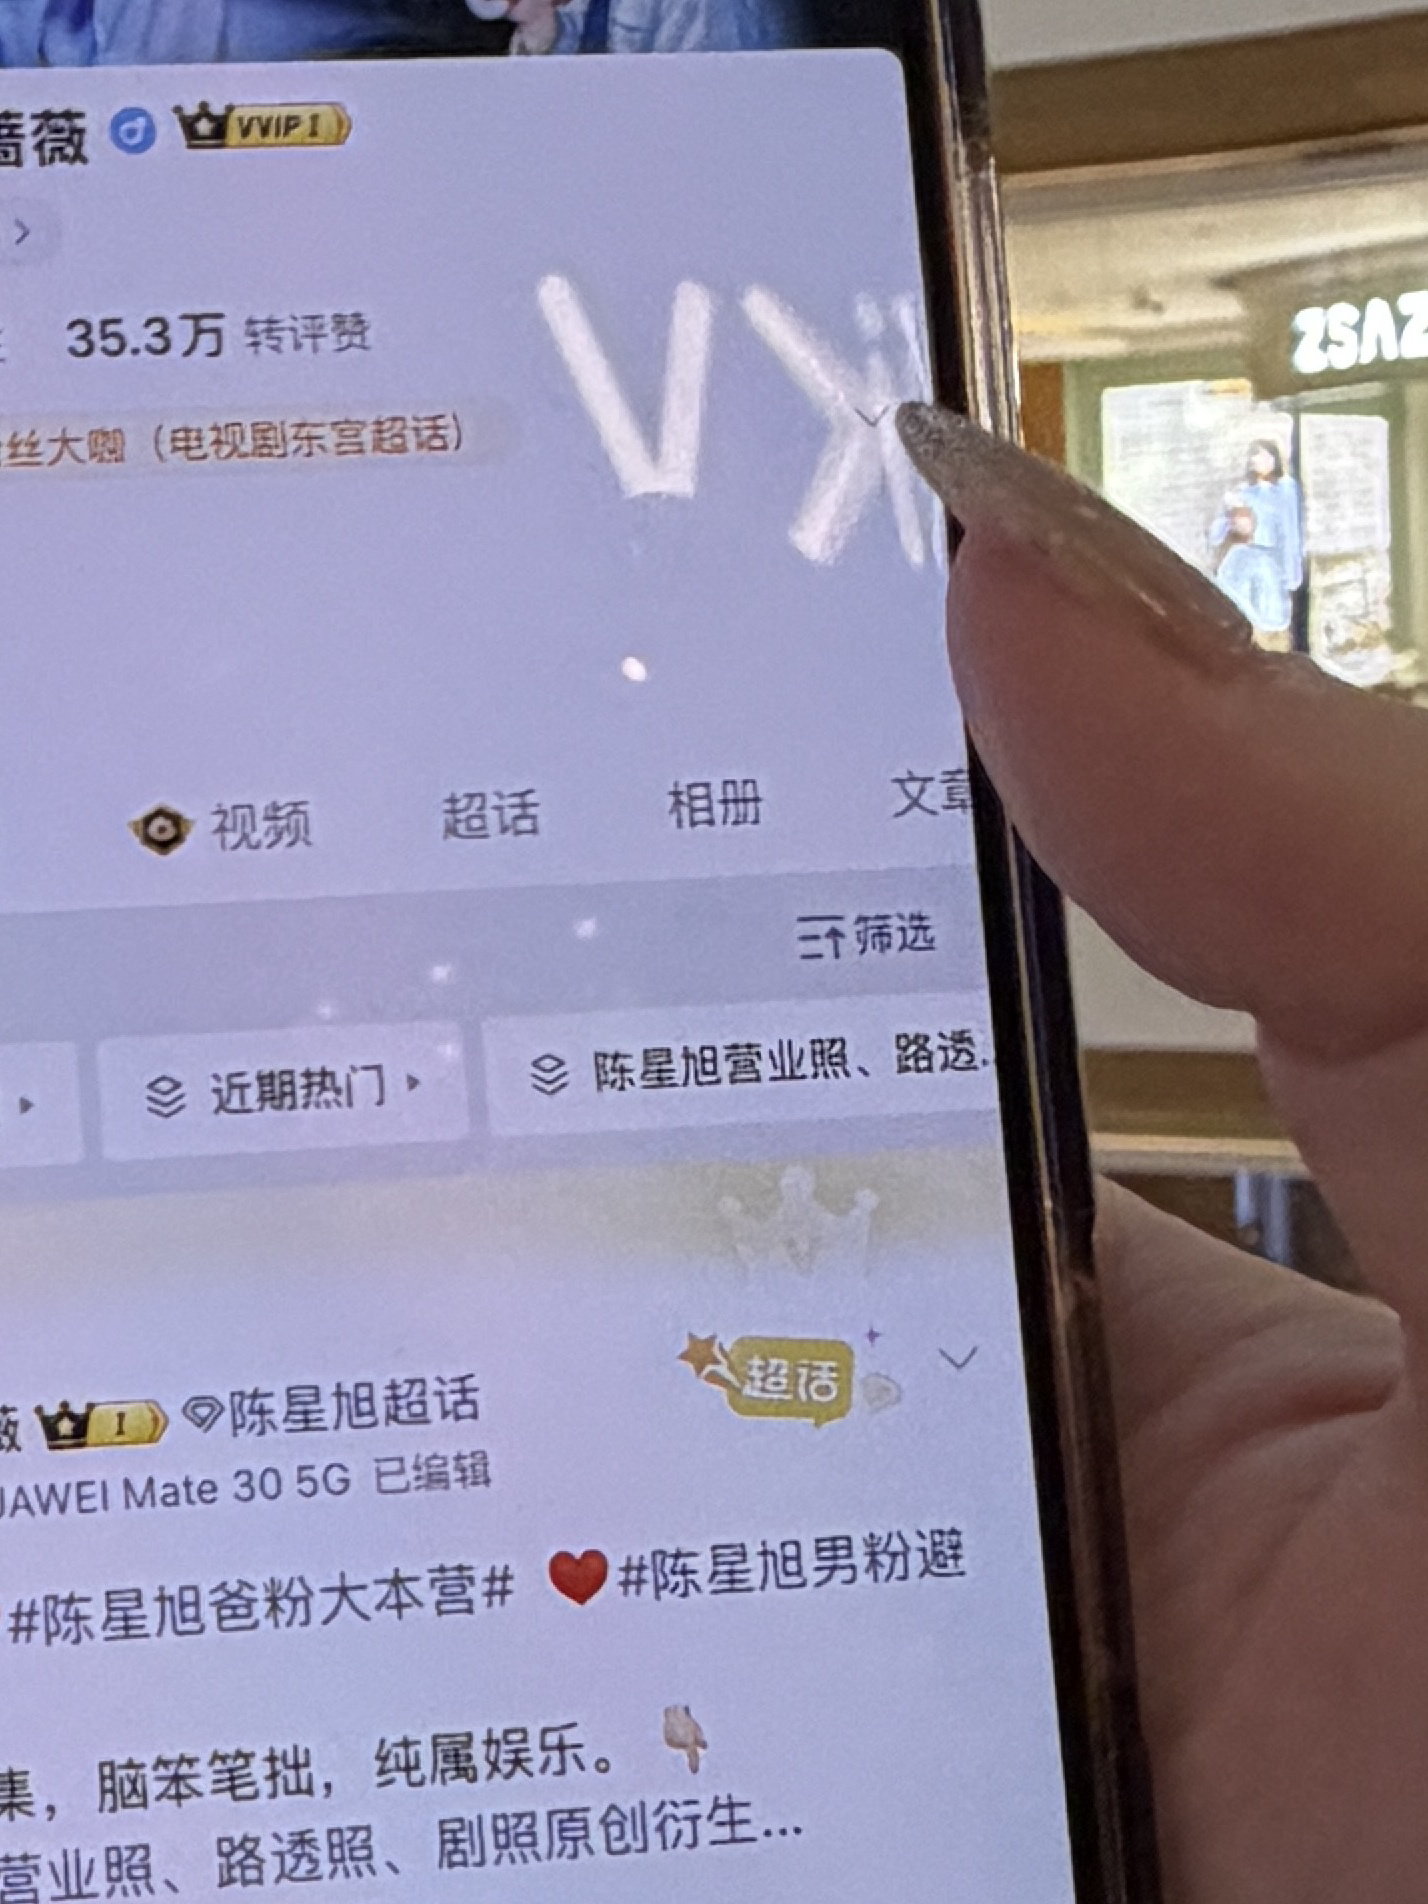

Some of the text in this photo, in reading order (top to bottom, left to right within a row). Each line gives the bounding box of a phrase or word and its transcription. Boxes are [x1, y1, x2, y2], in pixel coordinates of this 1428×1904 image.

[65, 311, 226, 359] 35.3万
[244, 311, 372, 355] 转评赞
[209, 799, 314, 851] 视频
[441, 788, 542, 841] 超话
[667, 778, 764, 830] 相册
[853, 910, 937, 957] 筛选
[210, 1063, 386, 1116] 近期热门
[229, 1372, 481, 1438] 陈星旭超话
[741, 1357, 841, 1403] 超话
[124, 1473, 219, 1510] Mate
[232, 1466, 283, 1501] 30
[295, 1461, 352, 1497] 5G
[373, 1449, 493, 1495] 已编辑
[7, 1563, 515, 1647] #陈星旭爸粉大本营#
[618, 1526, 966, 1601] #陈星旭男粉避
